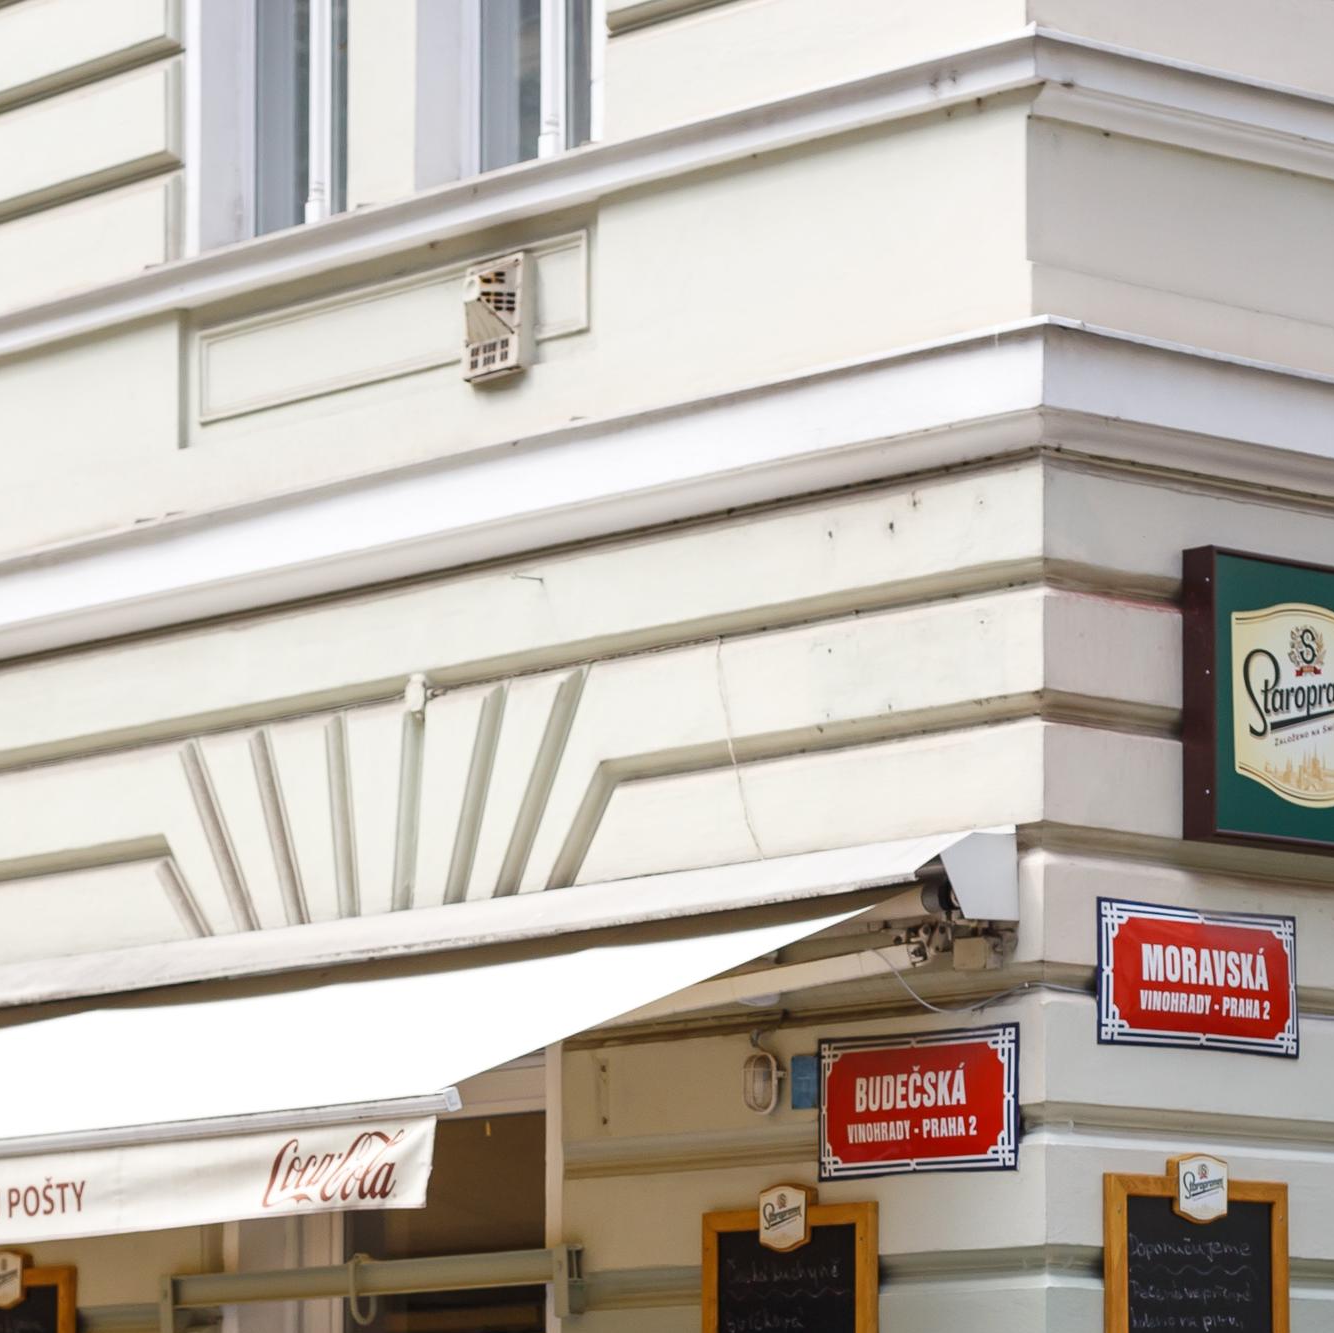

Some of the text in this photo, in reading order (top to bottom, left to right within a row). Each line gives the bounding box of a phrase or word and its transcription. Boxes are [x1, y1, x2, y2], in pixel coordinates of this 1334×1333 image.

[1141, 942, 1270, 992] MORAVSKÁ
[1139, 989, 1212, 1016] VINOHRADY
[1222, 996, 1259, 1019] PRAHA
[1262, 1000, 1271, 1021] 2
[854, 1062, 967, 1113] BUDEČSKÁ
[846, 1121, 911, 1145] VINOHRADY
[922, 1116, 966, 1138] PRAHA
[968, 1115, 977, 1136] 2
[262, 1129, 405, 1208] Coca-Cola
[8, 1175, 87, 1217] POŠTY
